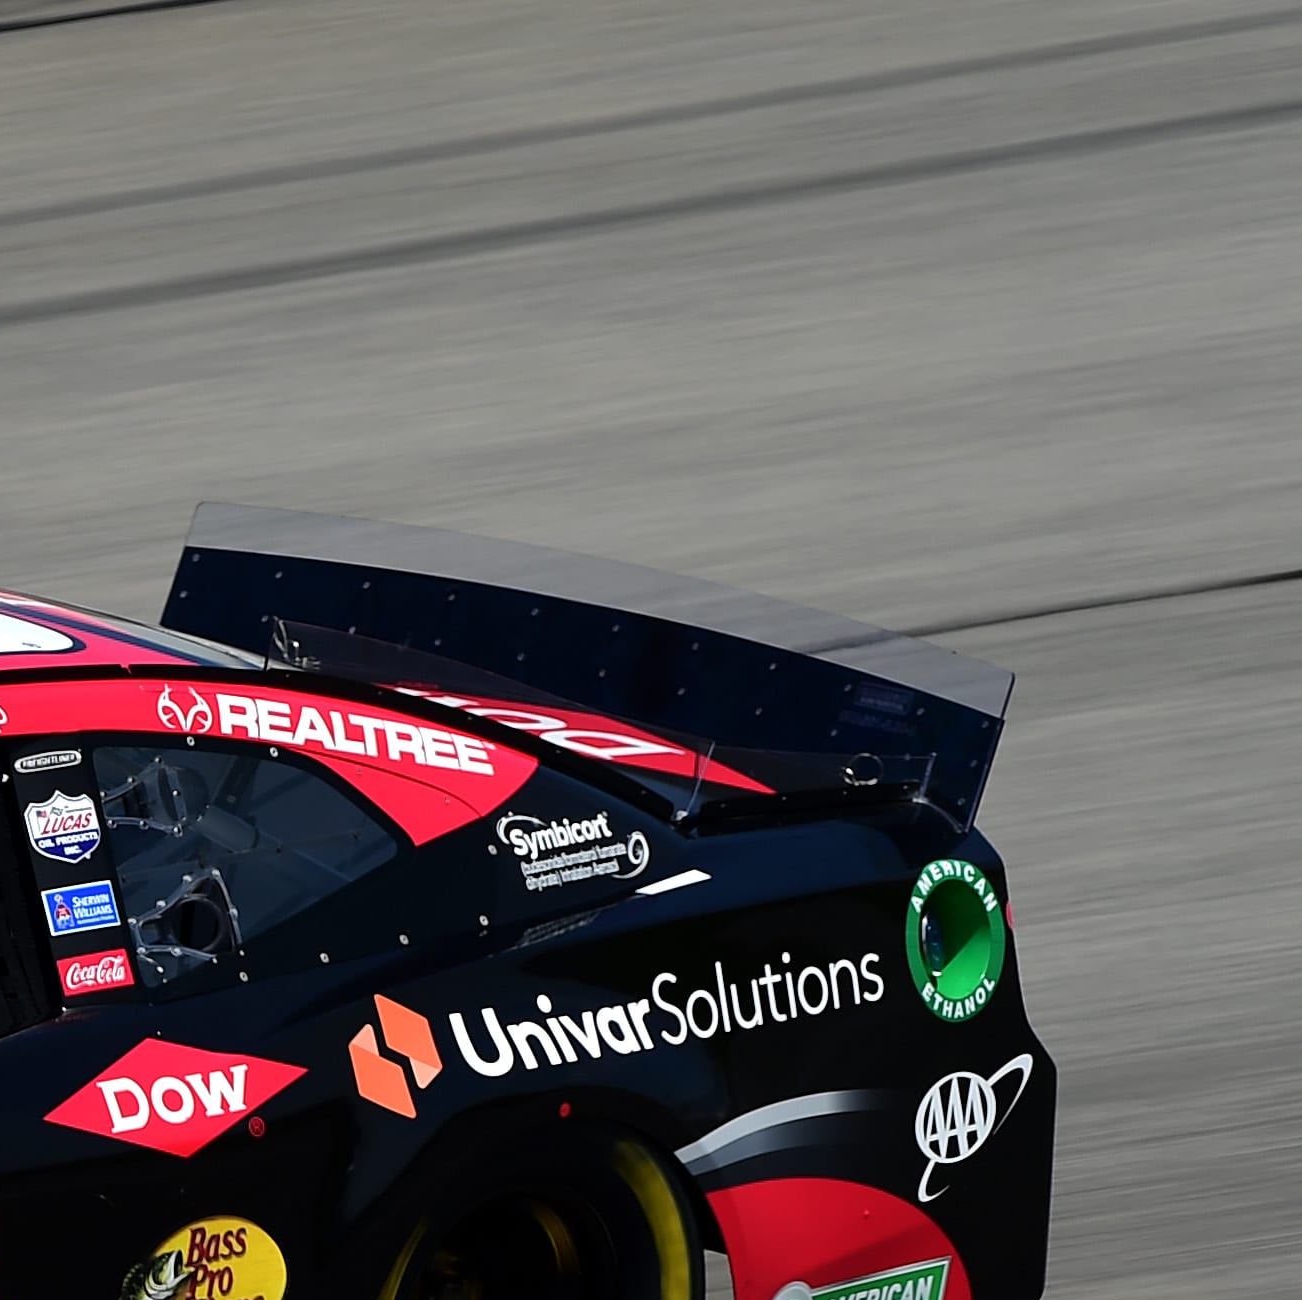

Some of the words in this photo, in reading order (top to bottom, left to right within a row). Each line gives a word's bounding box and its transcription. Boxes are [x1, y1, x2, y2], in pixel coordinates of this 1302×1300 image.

[216, 693, 495, 776] REALTREE
[37, 837, 55, 849] OIL
[56, 832, 98, 847] PRODUCTS
[41, 812, 93, 836] LUCAS
[509, 812, 613, 860] Symbicort
[63, 845, 83, 857] INC.
[72, 893, 110, 909] SHERWIN
[910, 860, 997, 913] AMERICAN
[72, 904, 114, 920] WILLIAMS
[921, 976, 996, 1020] ETHANOL
[96, 1063, 249, 1134] DOW
[921, 1074, 992, 1161] AAA
[184, 1226, 248, 1268] Bass
